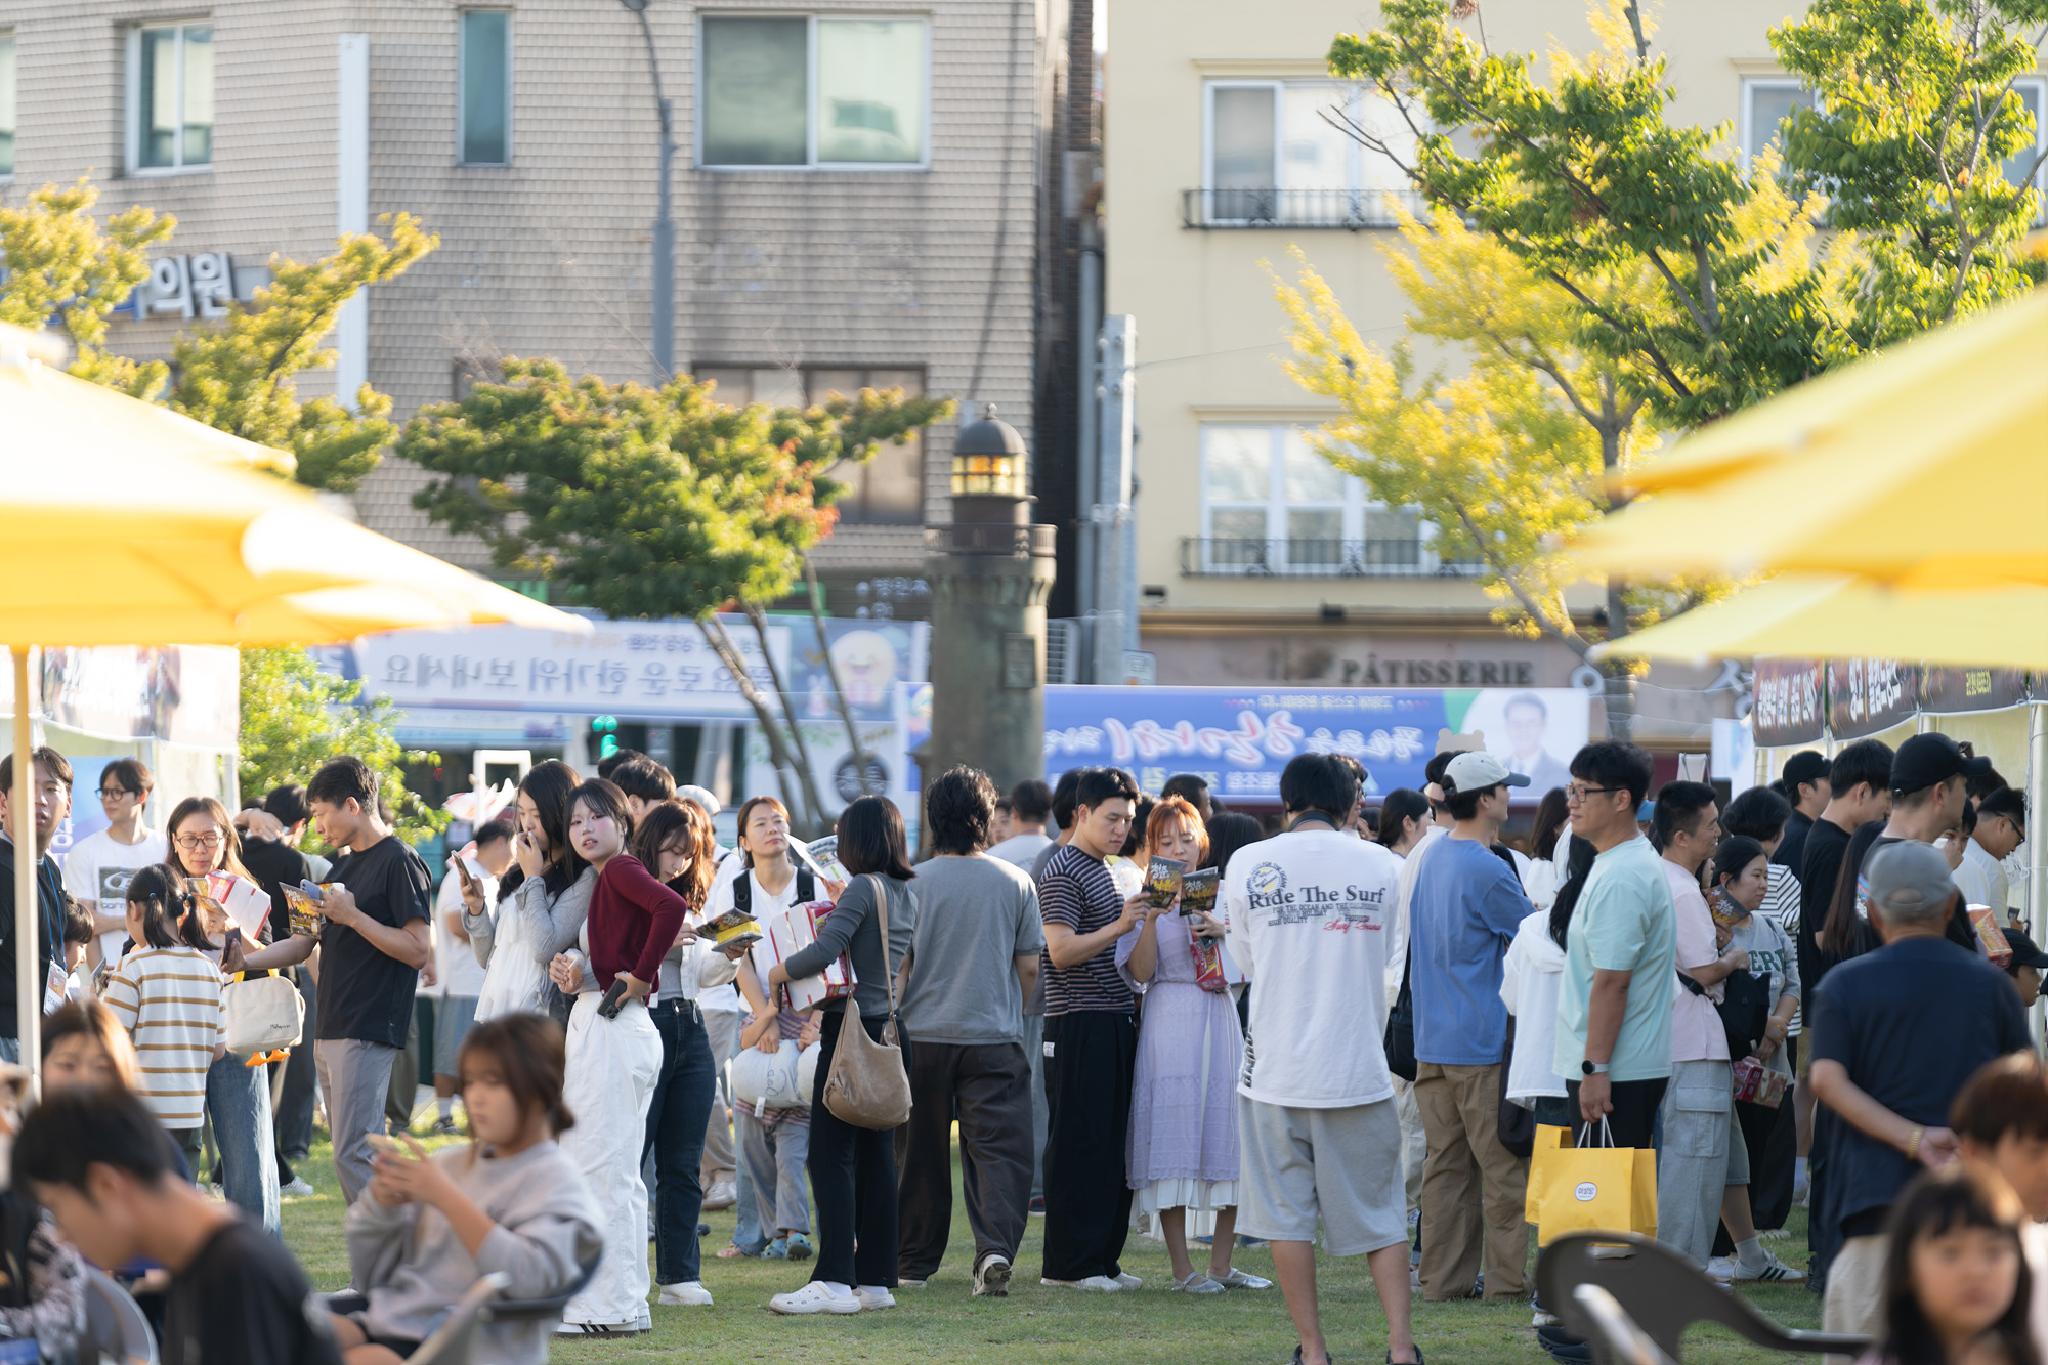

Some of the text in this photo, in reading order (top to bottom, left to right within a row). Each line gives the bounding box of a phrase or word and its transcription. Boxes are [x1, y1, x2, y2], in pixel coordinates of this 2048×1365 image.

[1340, 652, 1535, 684] PÂTISSERIE
[1248, 885, 1386, 910] Ride The Surf
